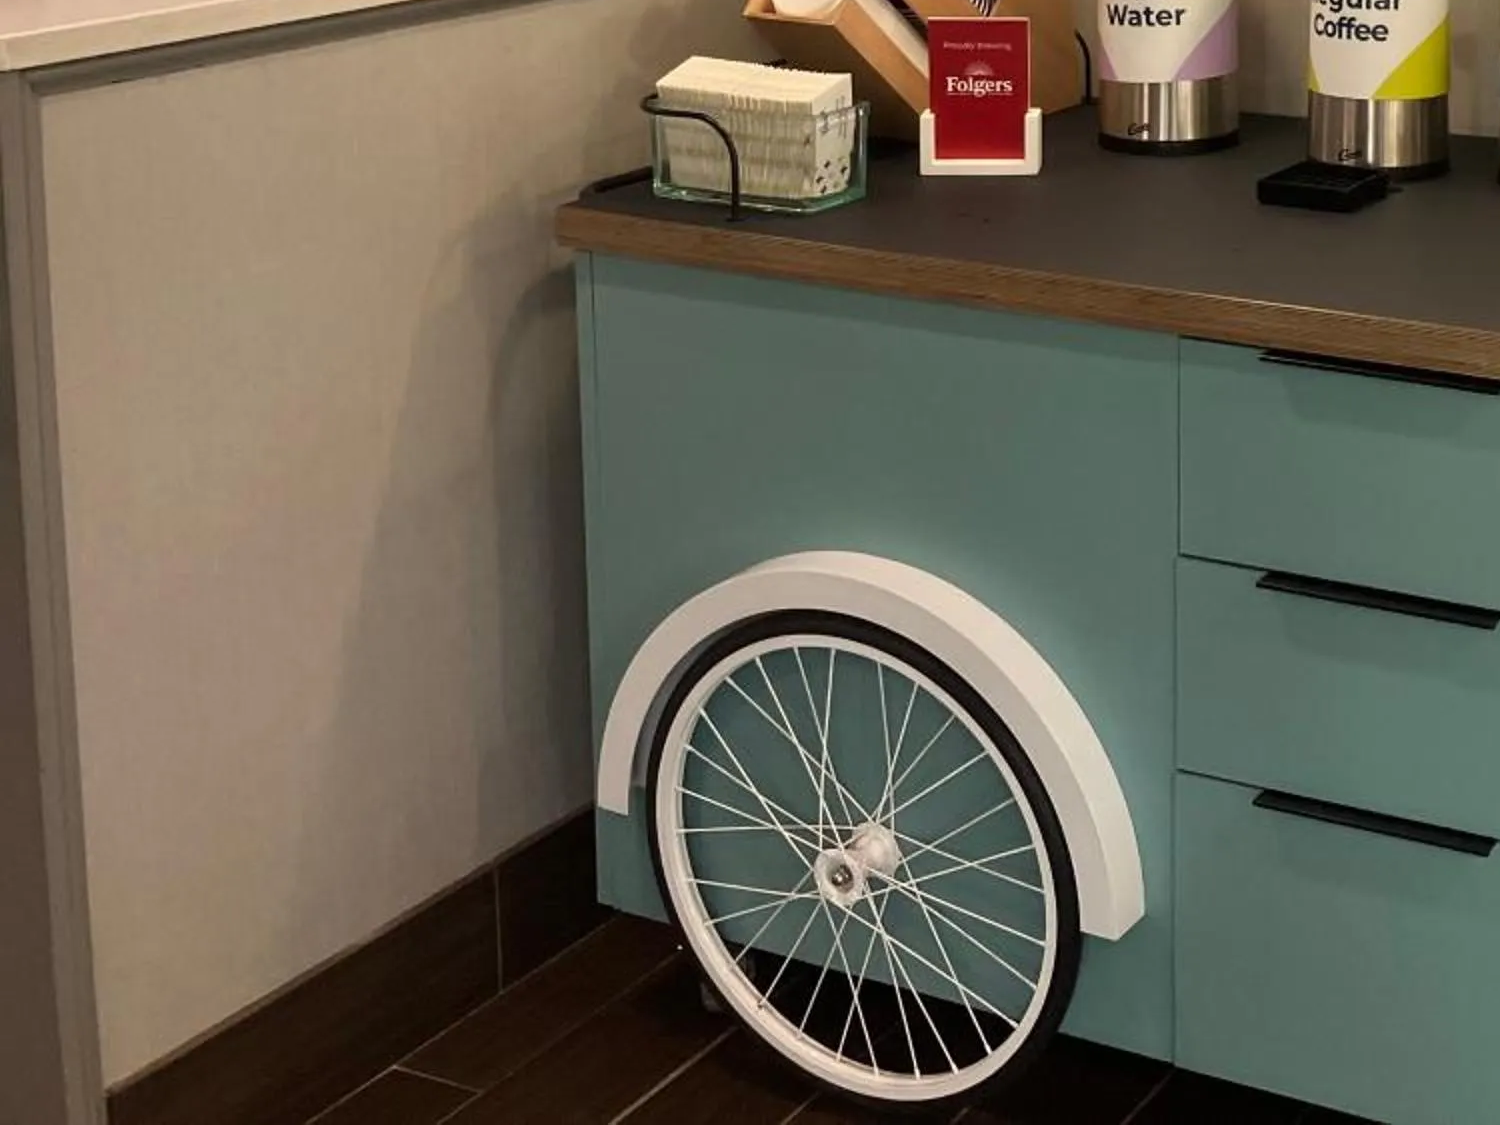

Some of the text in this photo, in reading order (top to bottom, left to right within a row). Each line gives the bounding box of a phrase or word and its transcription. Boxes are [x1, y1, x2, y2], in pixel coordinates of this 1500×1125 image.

[1106, 3, 1186, 27] Water
[1314, 13, 1389, 42] Coffee
[946, 76, 1013, 98] Folgers
